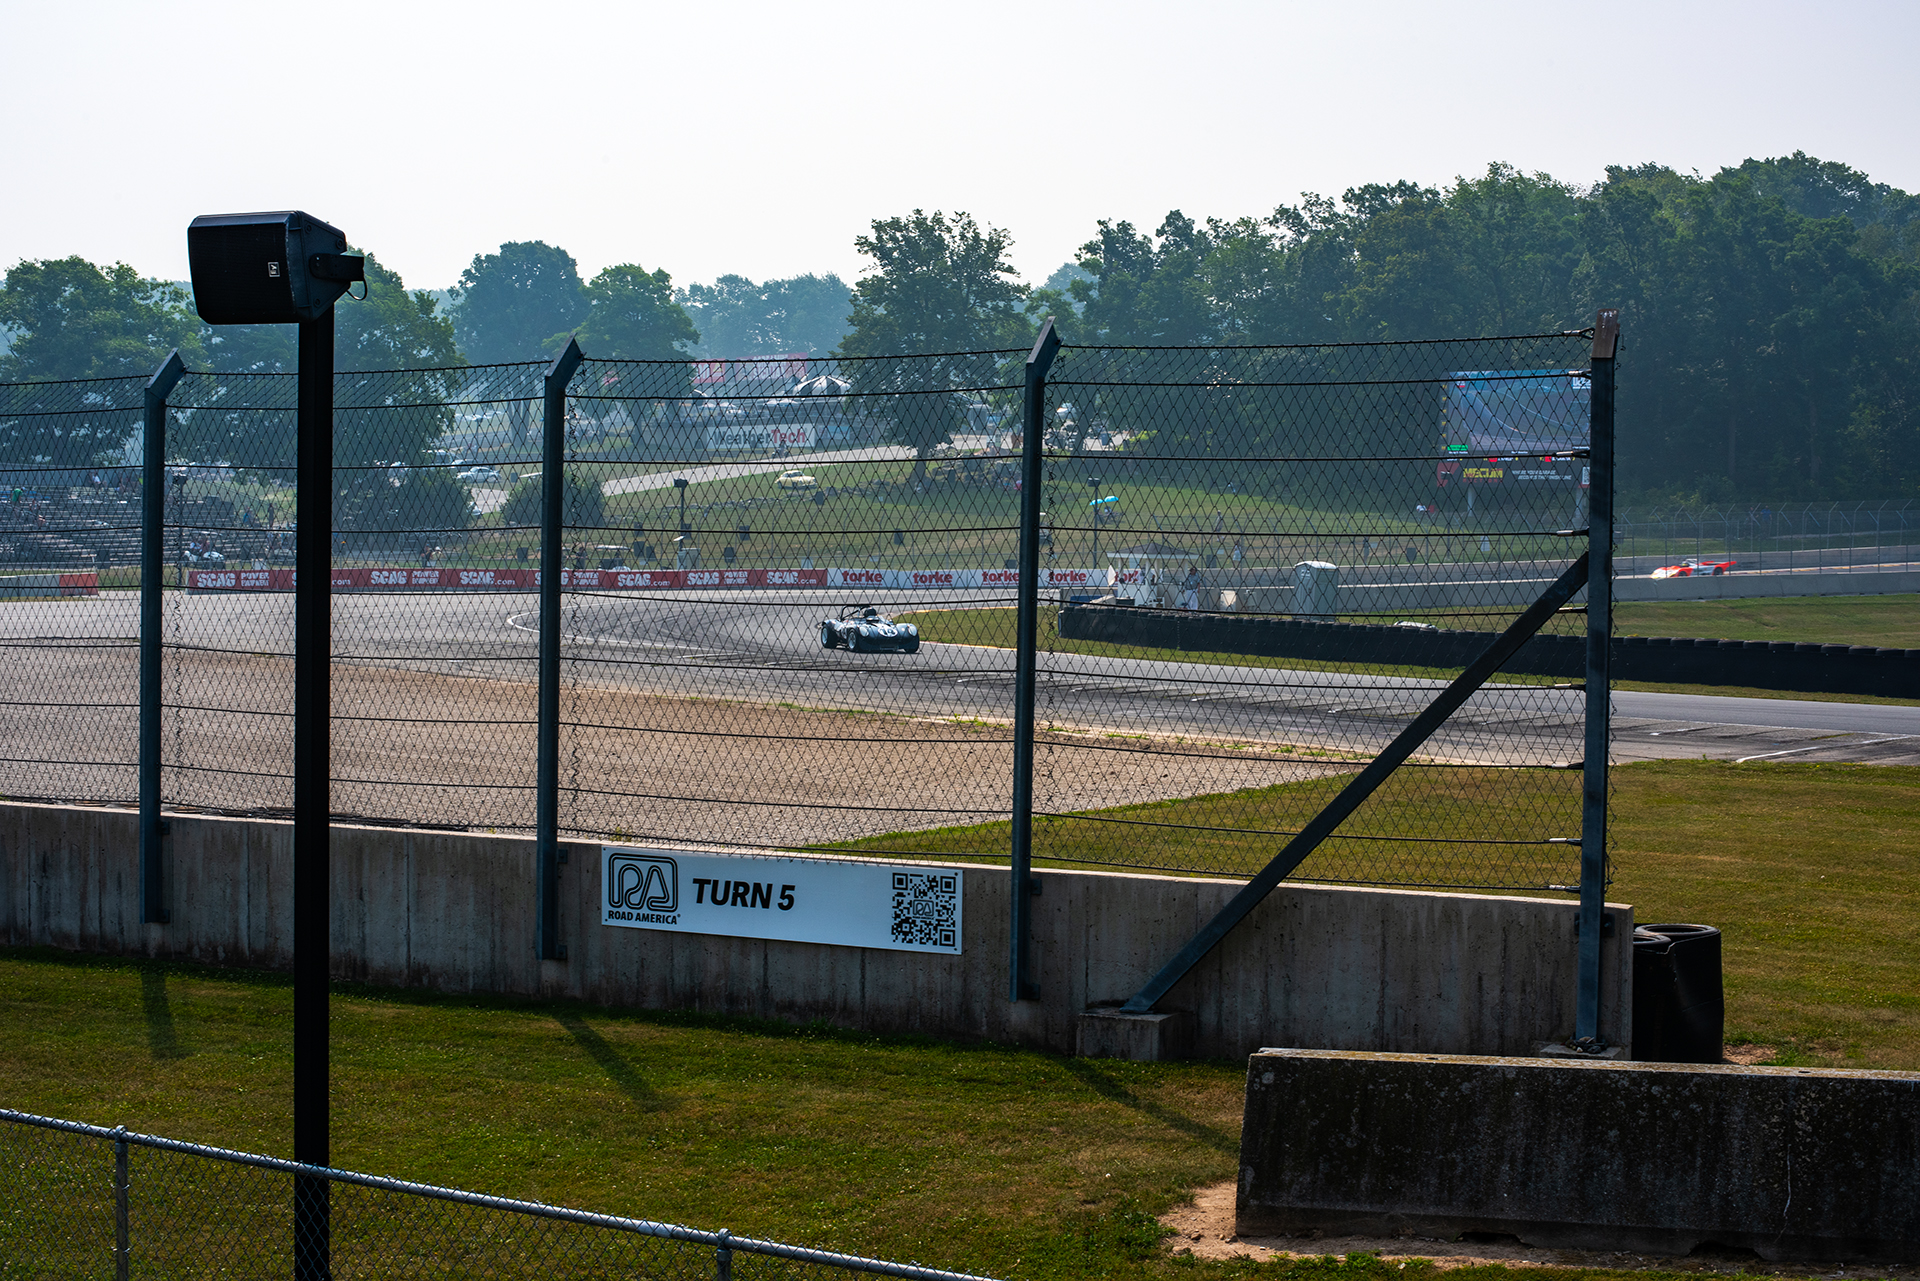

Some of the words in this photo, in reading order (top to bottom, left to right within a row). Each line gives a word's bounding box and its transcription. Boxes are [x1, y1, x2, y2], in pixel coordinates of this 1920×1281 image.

[714, 428, 806, 446] WeatherTech
[197, 573, 236, 587] SCAG
[371, 571, 408, 585] SCAG
[618, 574, 671, 587] SCAG.com
[687, 572, 720, 585] SCAG
[767, 571, 817, 585] SCAG.com
[842, 570, 883, 582] torke
[912, 571, 953, 583] torke
[1049, 571, 1087, 582] torke
[692, 878, 773, 909] TURN
[777, 884, 796, 911] 5
[608, 910, 633, 921] ROAD
[635, 912, 678, 925] AMERICA
